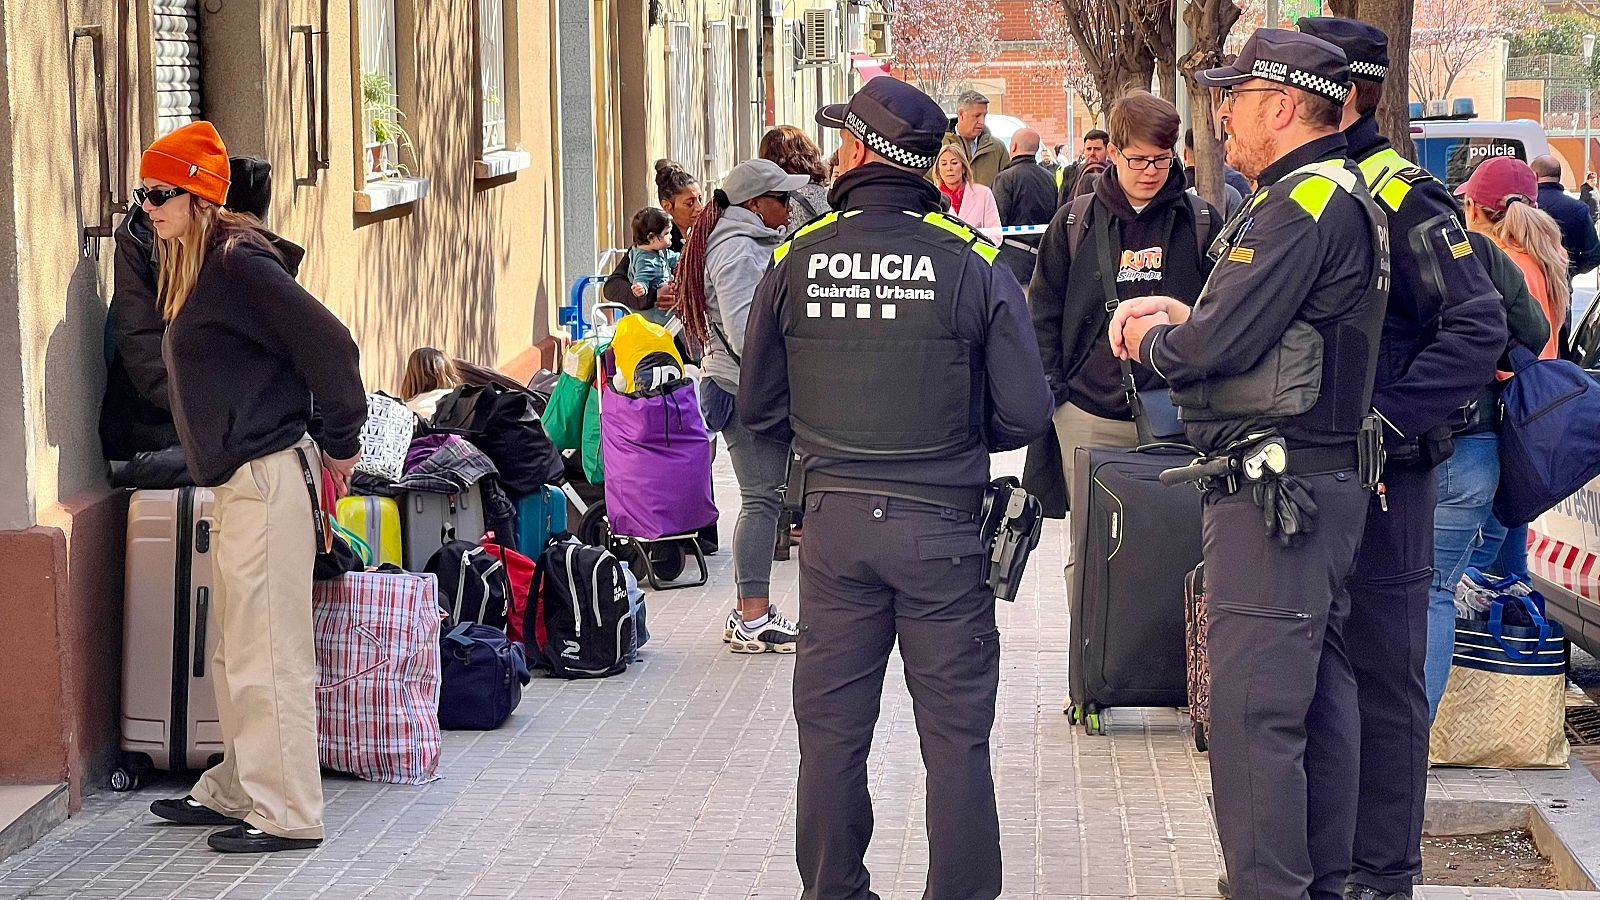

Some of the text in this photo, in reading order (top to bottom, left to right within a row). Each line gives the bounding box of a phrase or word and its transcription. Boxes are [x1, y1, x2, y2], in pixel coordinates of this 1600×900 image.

[1253, 59, 1288, 76] POLICIA
[845, 111, 867, 136] POLICIA
[1469, 143, 1516, 159] policia
[807, 252, 936, 282] POLICIA
[806, 283, 935, 300] Guàrdia Urbana
